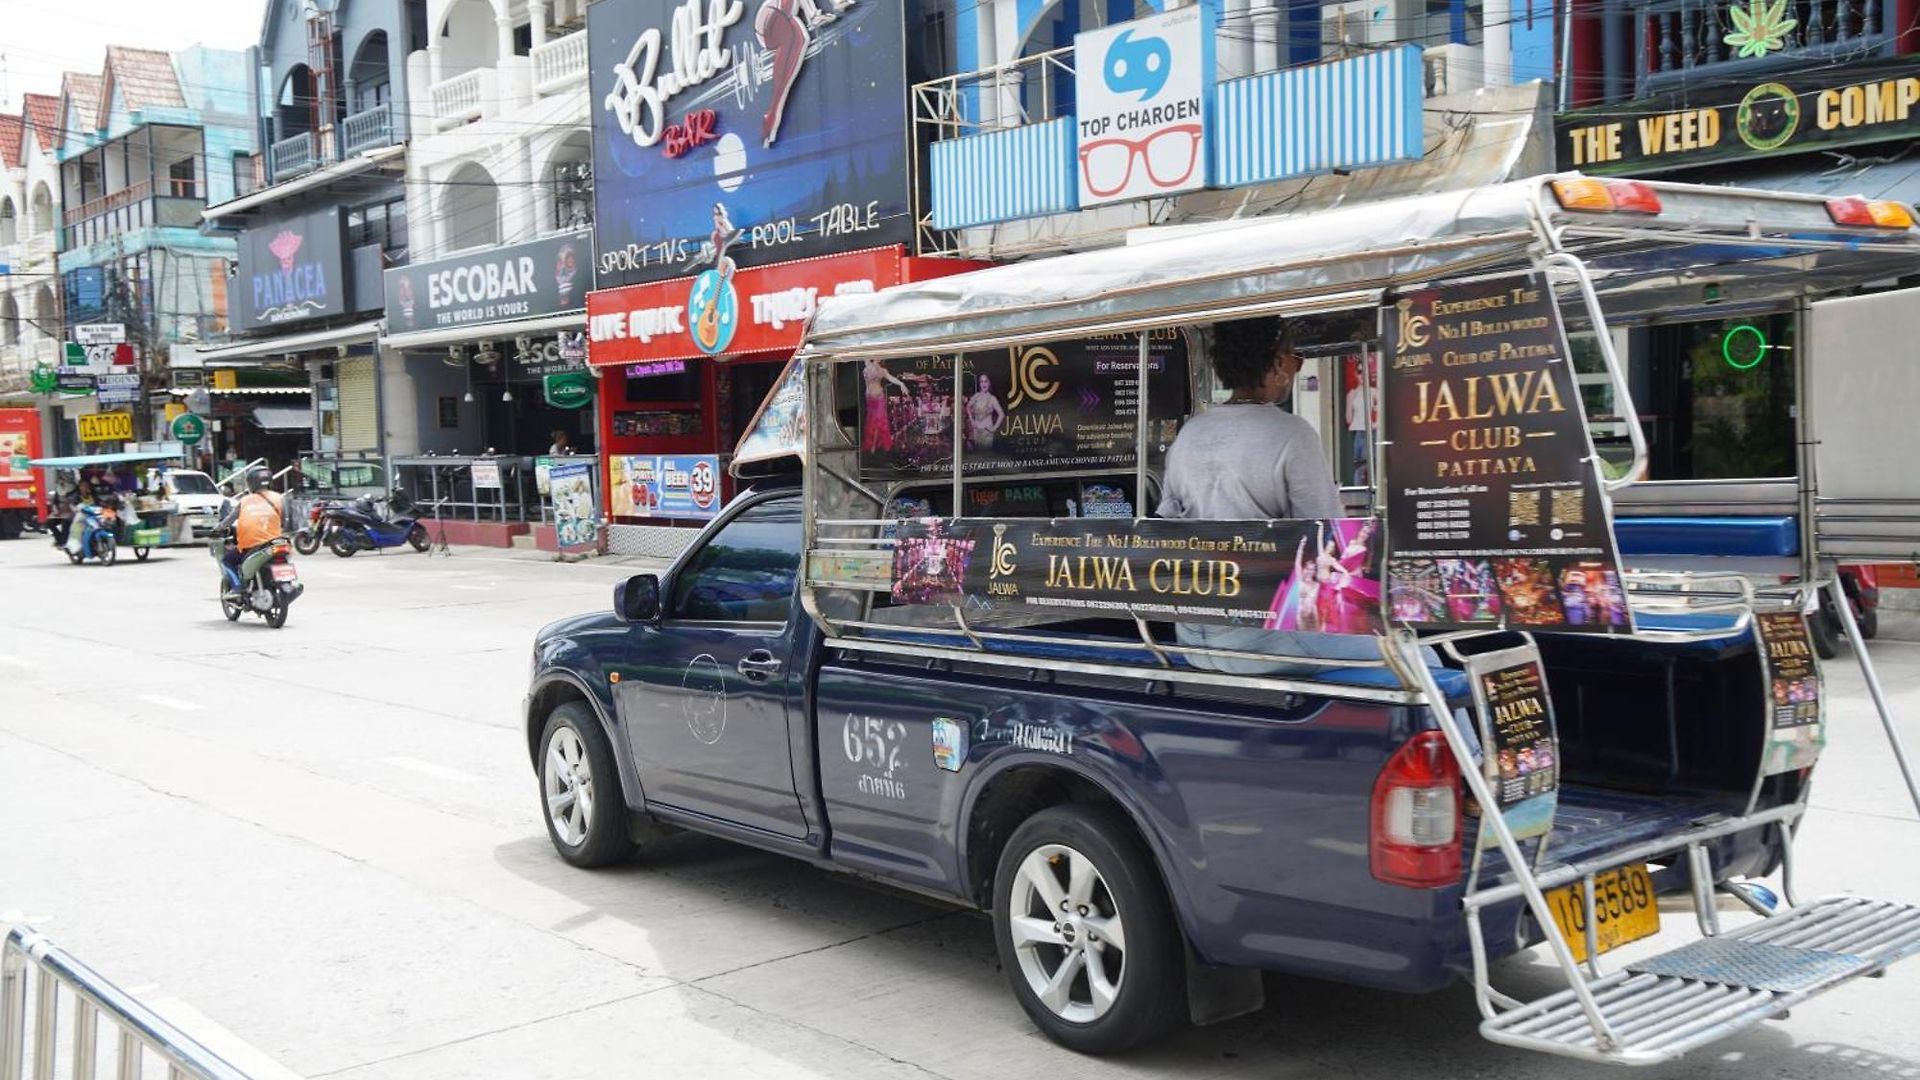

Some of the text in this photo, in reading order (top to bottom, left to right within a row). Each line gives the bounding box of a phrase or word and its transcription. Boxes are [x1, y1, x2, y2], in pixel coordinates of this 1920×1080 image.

[1081, 97, 1200, 138] TOP CHAROEN
[1570, 77, 1920, 165] THE WEED COMP
[661, 107, 721, 159] BAR
[752, 200, 881, 249] POOL TABLE
[600, 238, 688, 275] SPORT TVS
[252, 261, 327, 308] PANACEA
[428, 256, 538, 309] ESCOBAR
[437, 301, 529, 324] THE WORLD IS YOURS
[1431, 287, 1541, 316] EXPERIENCE THE
[590, 305, 685, 343] LIVE MUSIC
[1096, 362, 1109, 370] For
[1479, 349, 1498, 363] OF
[1411, 367, 1567, 424] JALWA
[81, 416, 131, 438] TATTOO
[1000, 413, 1064, 436] JALWA
[1451, 426, 1522, 452] CLUB
[692, 467, 713, 494] 39
[1436, 456, 1537, 478] PATTAYA
[969, 486, 1046, 506] Tiger PARK
[1031, 532, 1081, 547] EXPERIENCE
[1188, 536, 1216, 551] CLUB
[1216, 541, 1231, 551] OF
[1232, 535, 1278, 553] PATTAYA
[987, 582, 1020, 596] JALWA
[1044, 554, 1241, 597] JALWA CLUB
[1494, 697, 1544, 725] JALWA
[843, 712, 909, 771] 652
